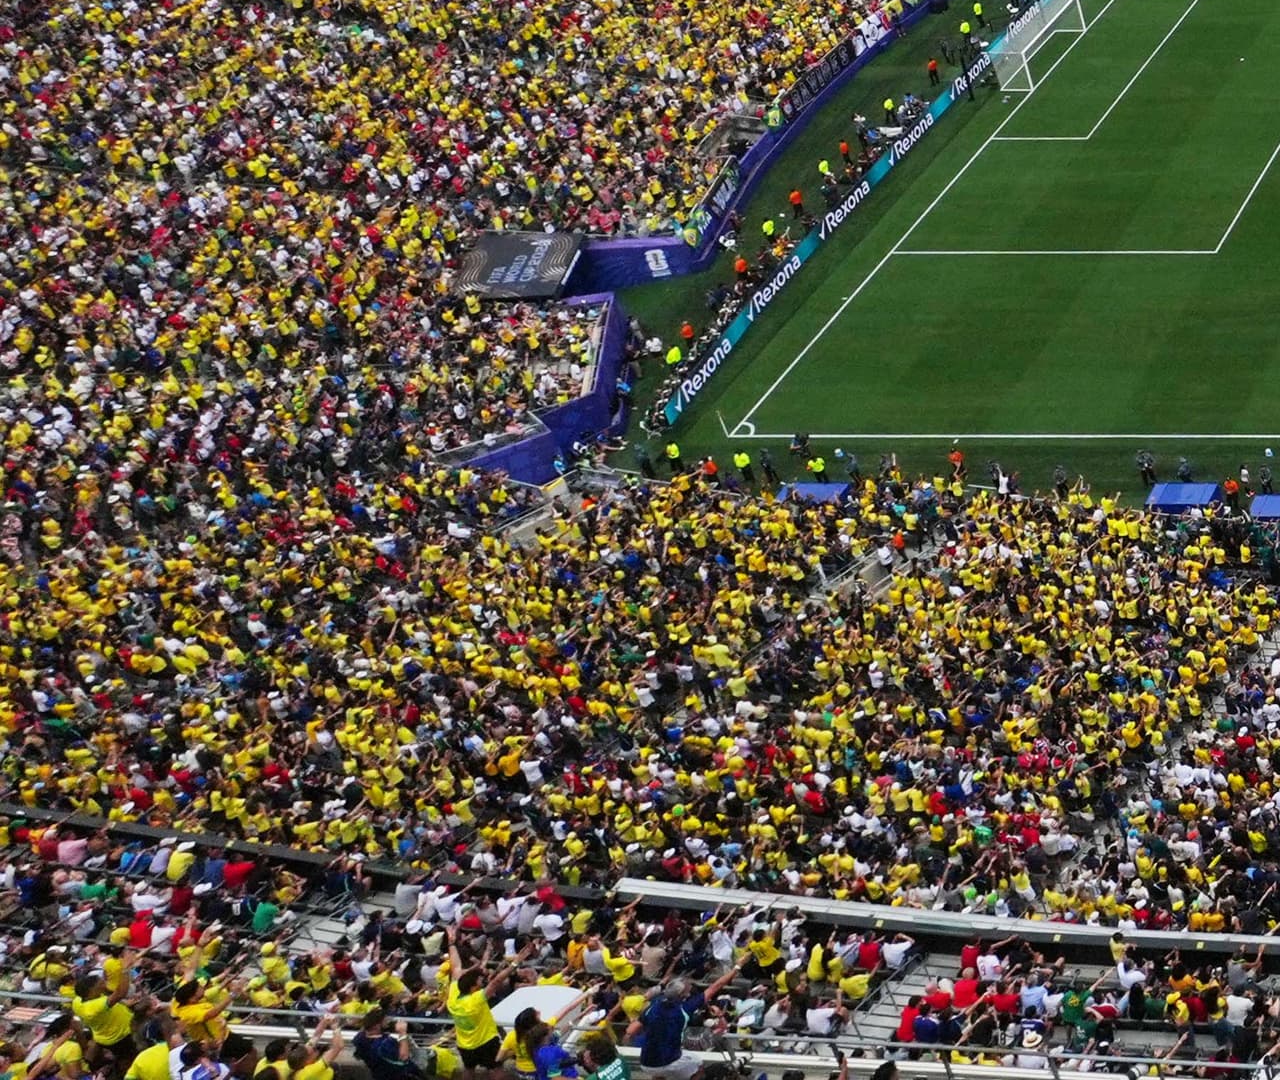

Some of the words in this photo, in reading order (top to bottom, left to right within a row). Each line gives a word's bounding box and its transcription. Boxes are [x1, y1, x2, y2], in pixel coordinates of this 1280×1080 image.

[1008, 2, 1041, 38] Rexona
[894, 111, 934, 160] Rexona
[824, 178, 871, 234] Rexona
[752, 253, 802, 314] Rexona
[682, 337, 733, 403] Rexona
